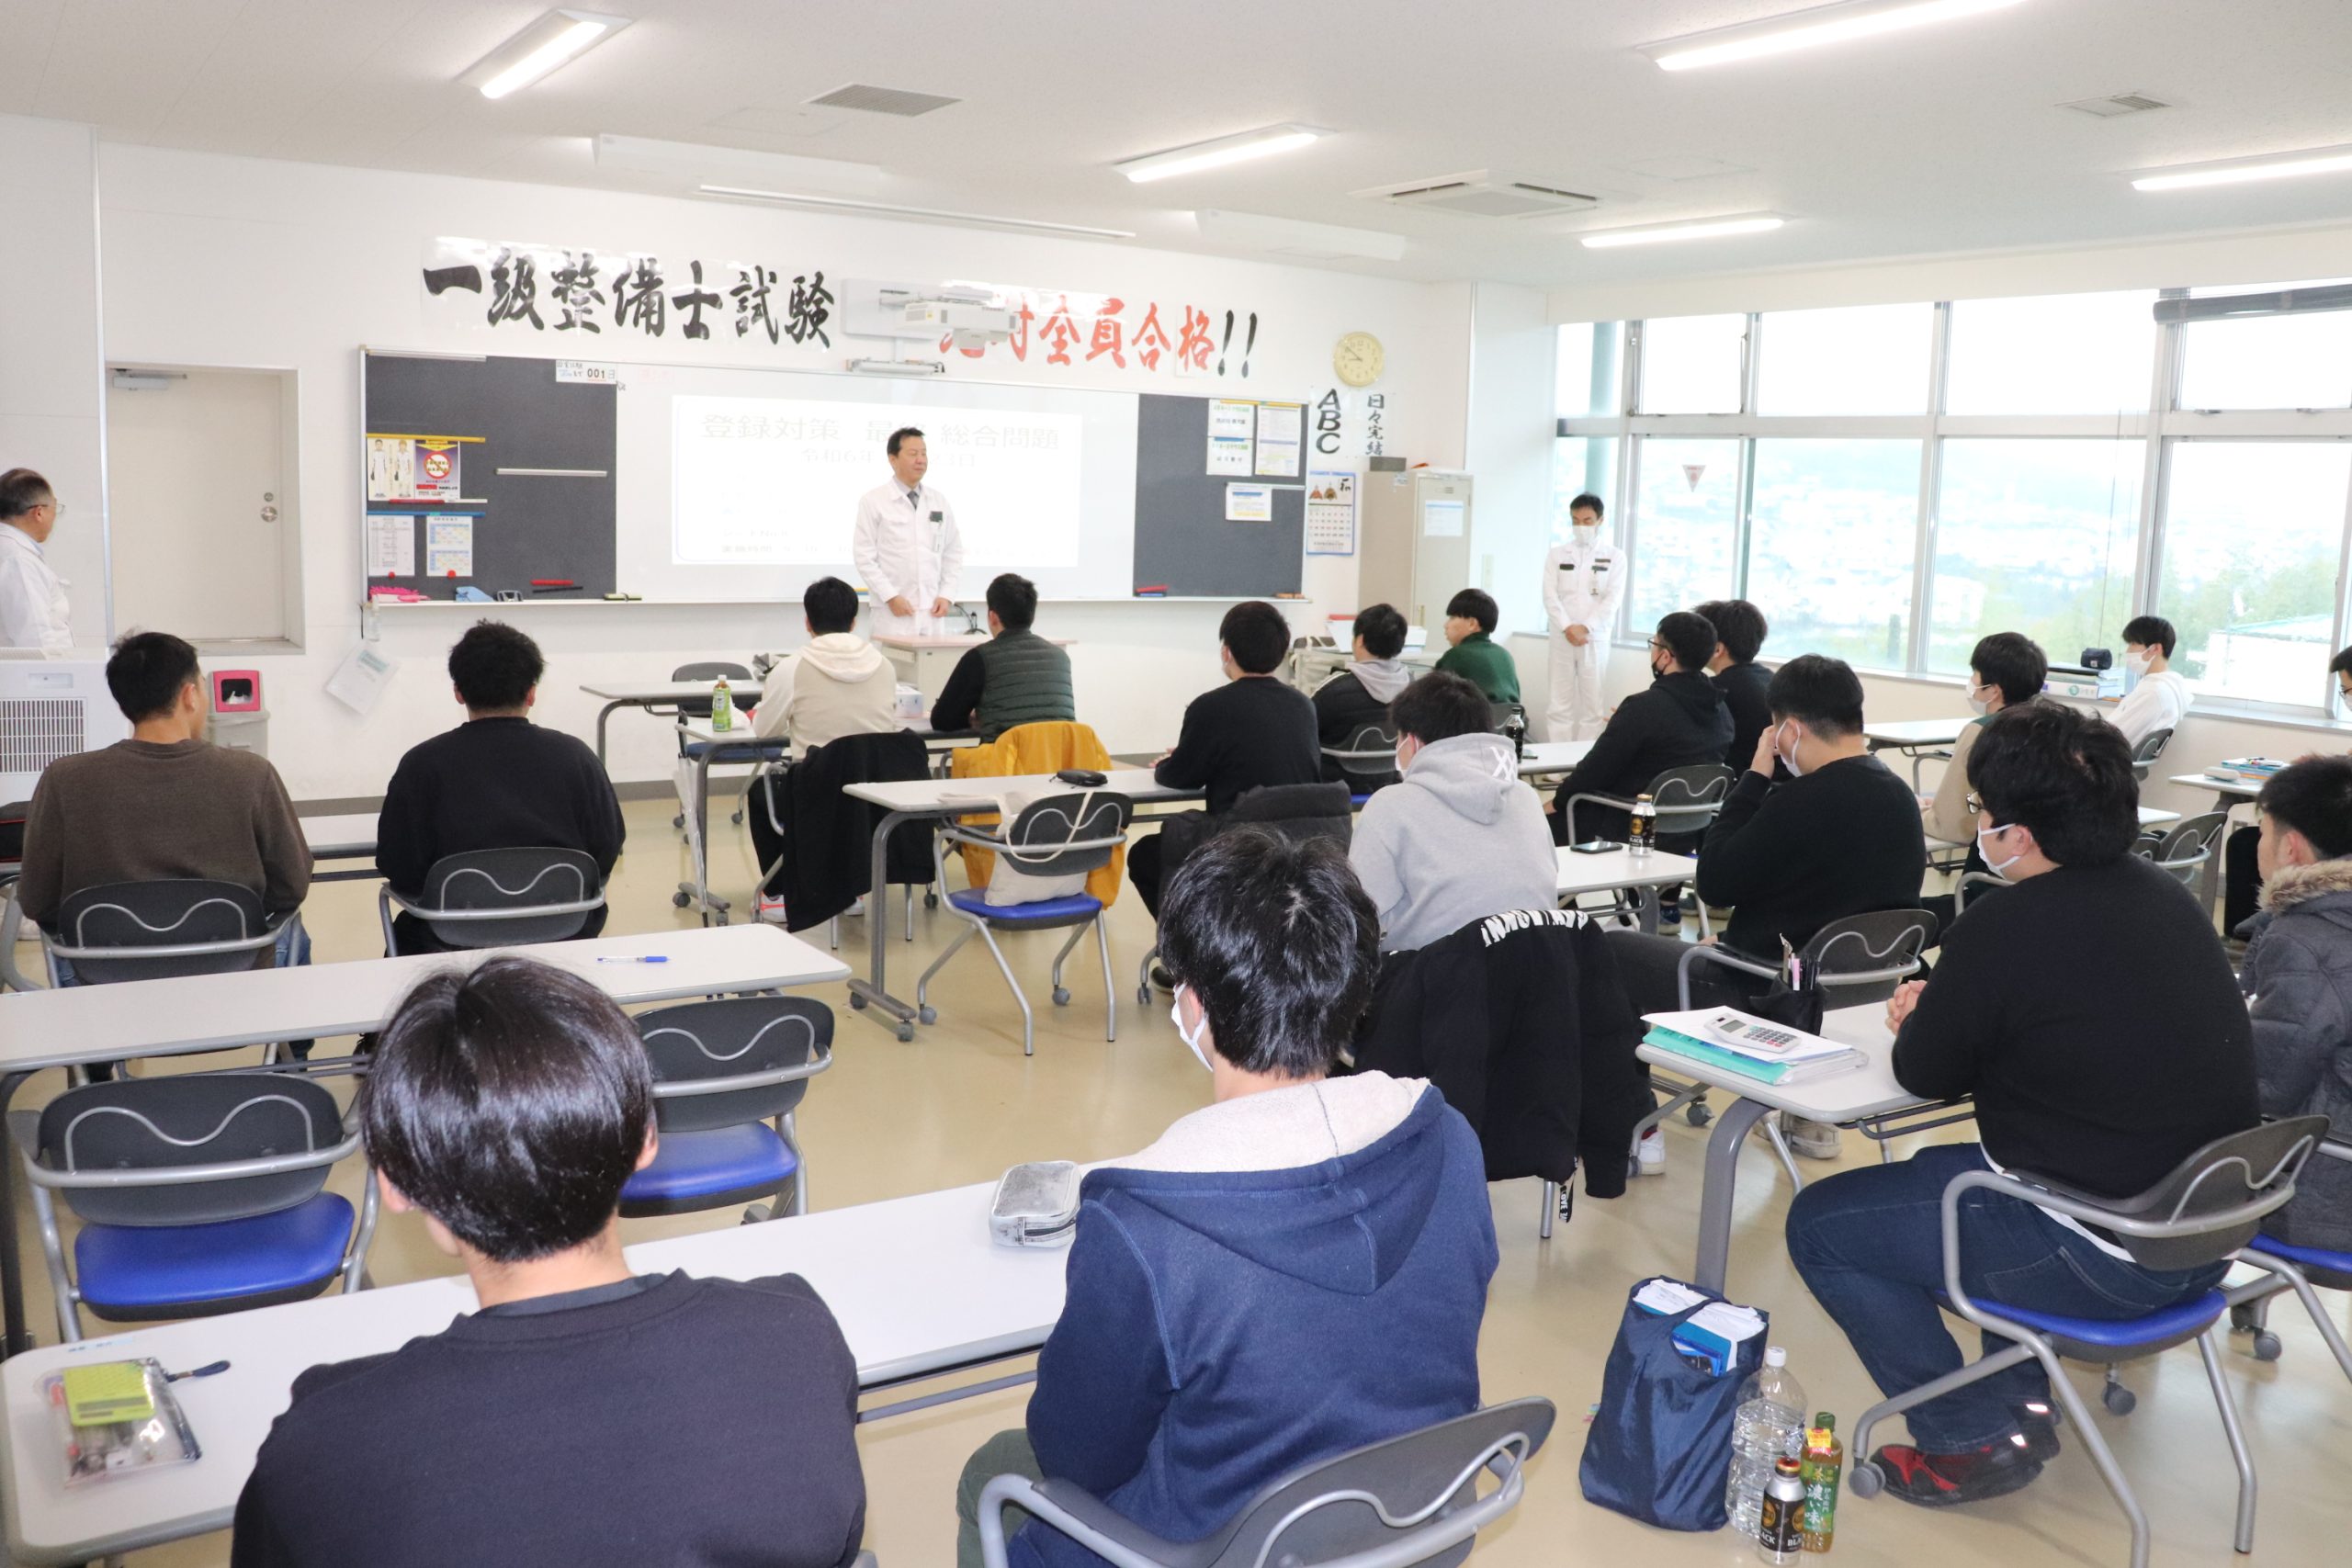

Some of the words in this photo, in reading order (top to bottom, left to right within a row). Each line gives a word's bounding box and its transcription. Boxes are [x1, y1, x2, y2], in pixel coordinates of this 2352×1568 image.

[423, 248, 834, 348] 一級整備士試験
[701, 413, 841, 442] 登録対策
[940, 423, 1060, 451] 総合問題
